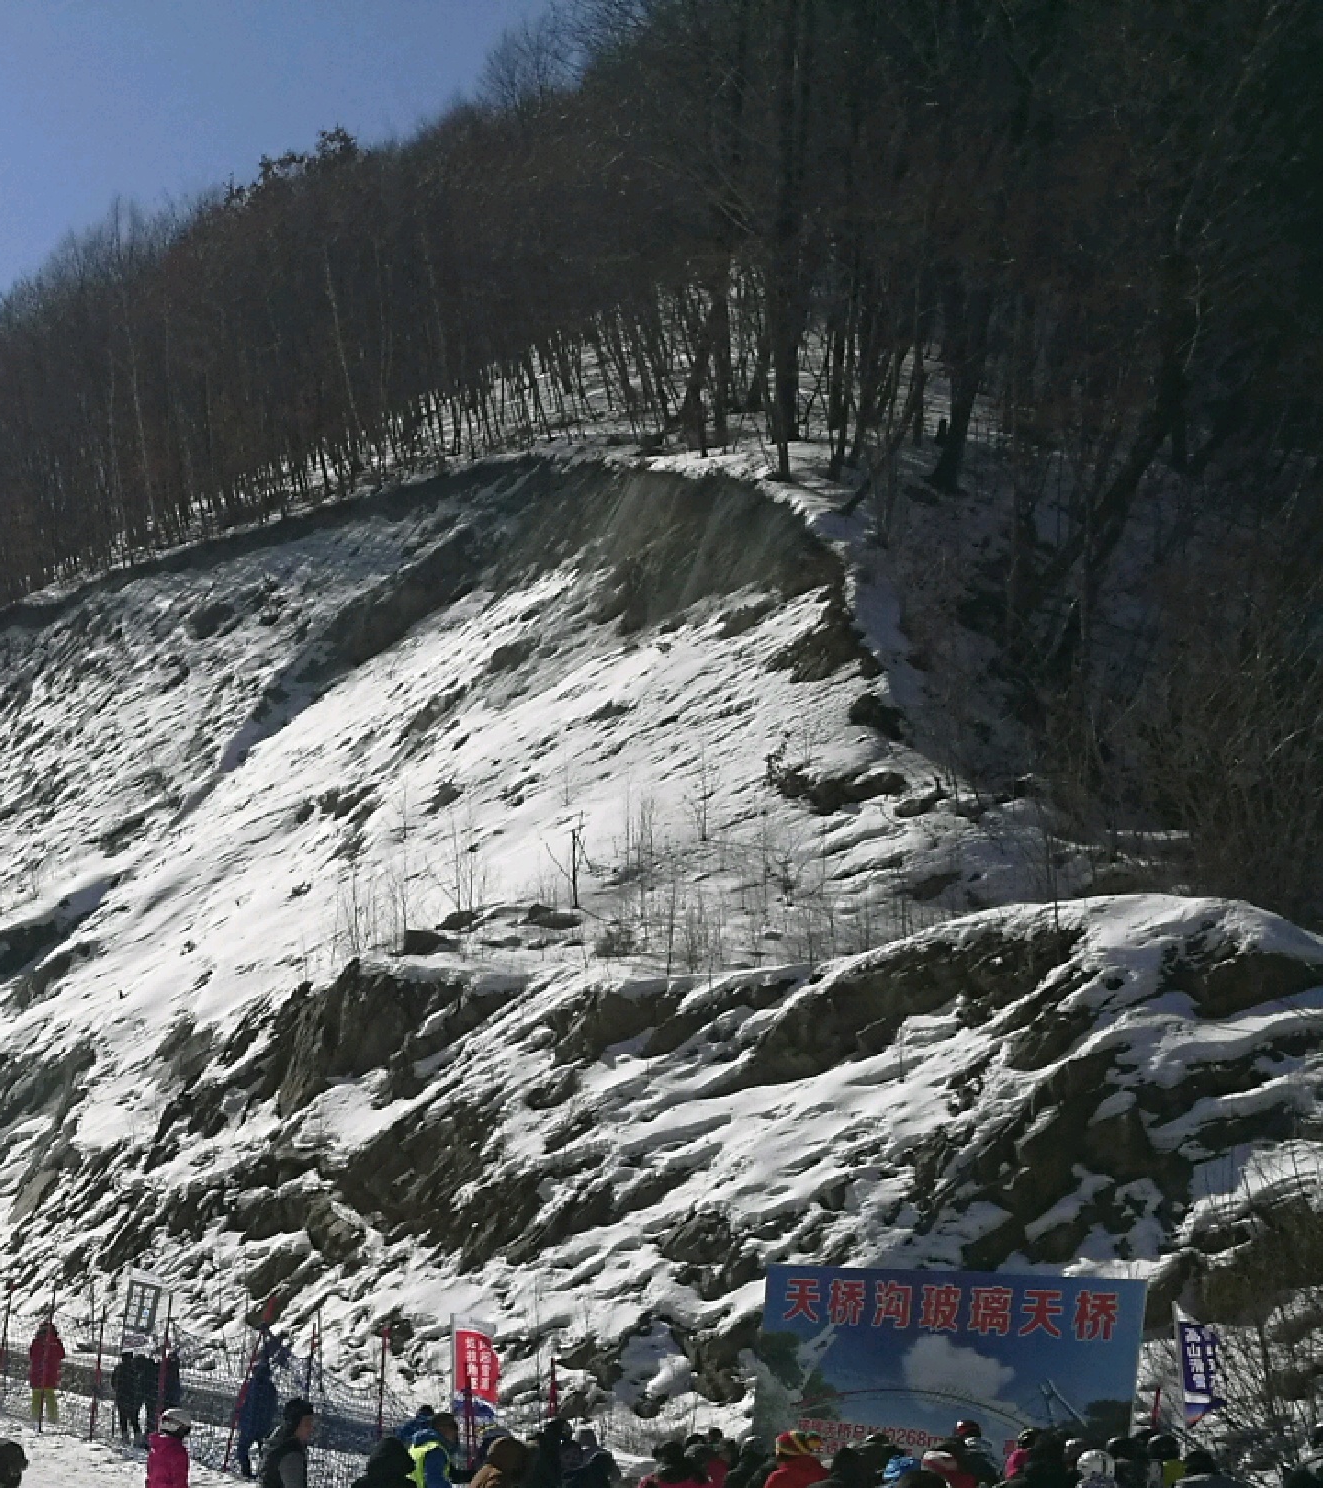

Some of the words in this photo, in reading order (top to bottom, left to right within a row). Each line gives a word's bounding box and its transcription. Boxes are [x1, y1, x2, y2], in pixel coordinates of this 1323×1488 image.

[783, 1278, 1119, 1341] 天桥沟玻璃天桥
